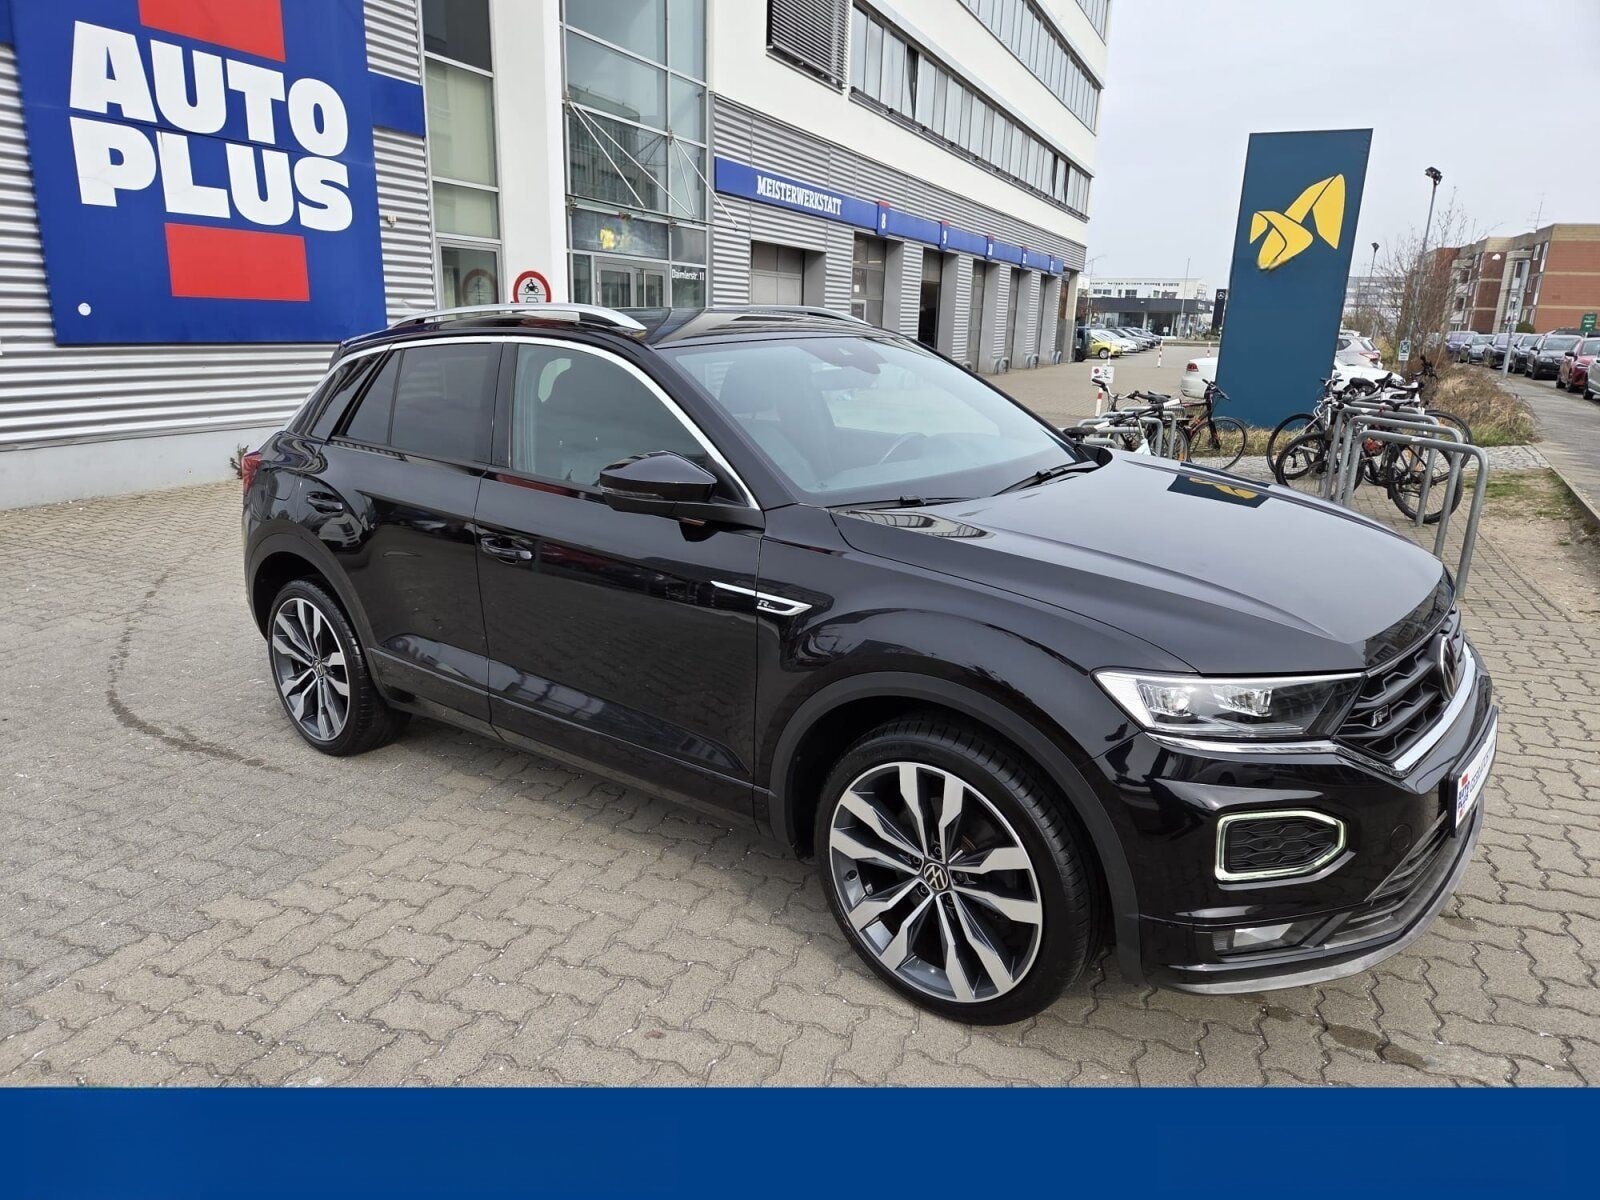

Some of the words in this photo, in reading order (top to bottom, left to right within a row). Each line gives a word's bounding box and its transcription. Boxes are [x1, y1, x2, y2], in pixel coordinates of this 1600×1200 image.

[69, 20, 348, 157] AUTO
[69, 116, 353, 232] PLUS
[756, 174, 842, 216] MEISTERWERKSTATT
[881, 213, 886, 229] 8
[943, 230, 947, 244] 9
